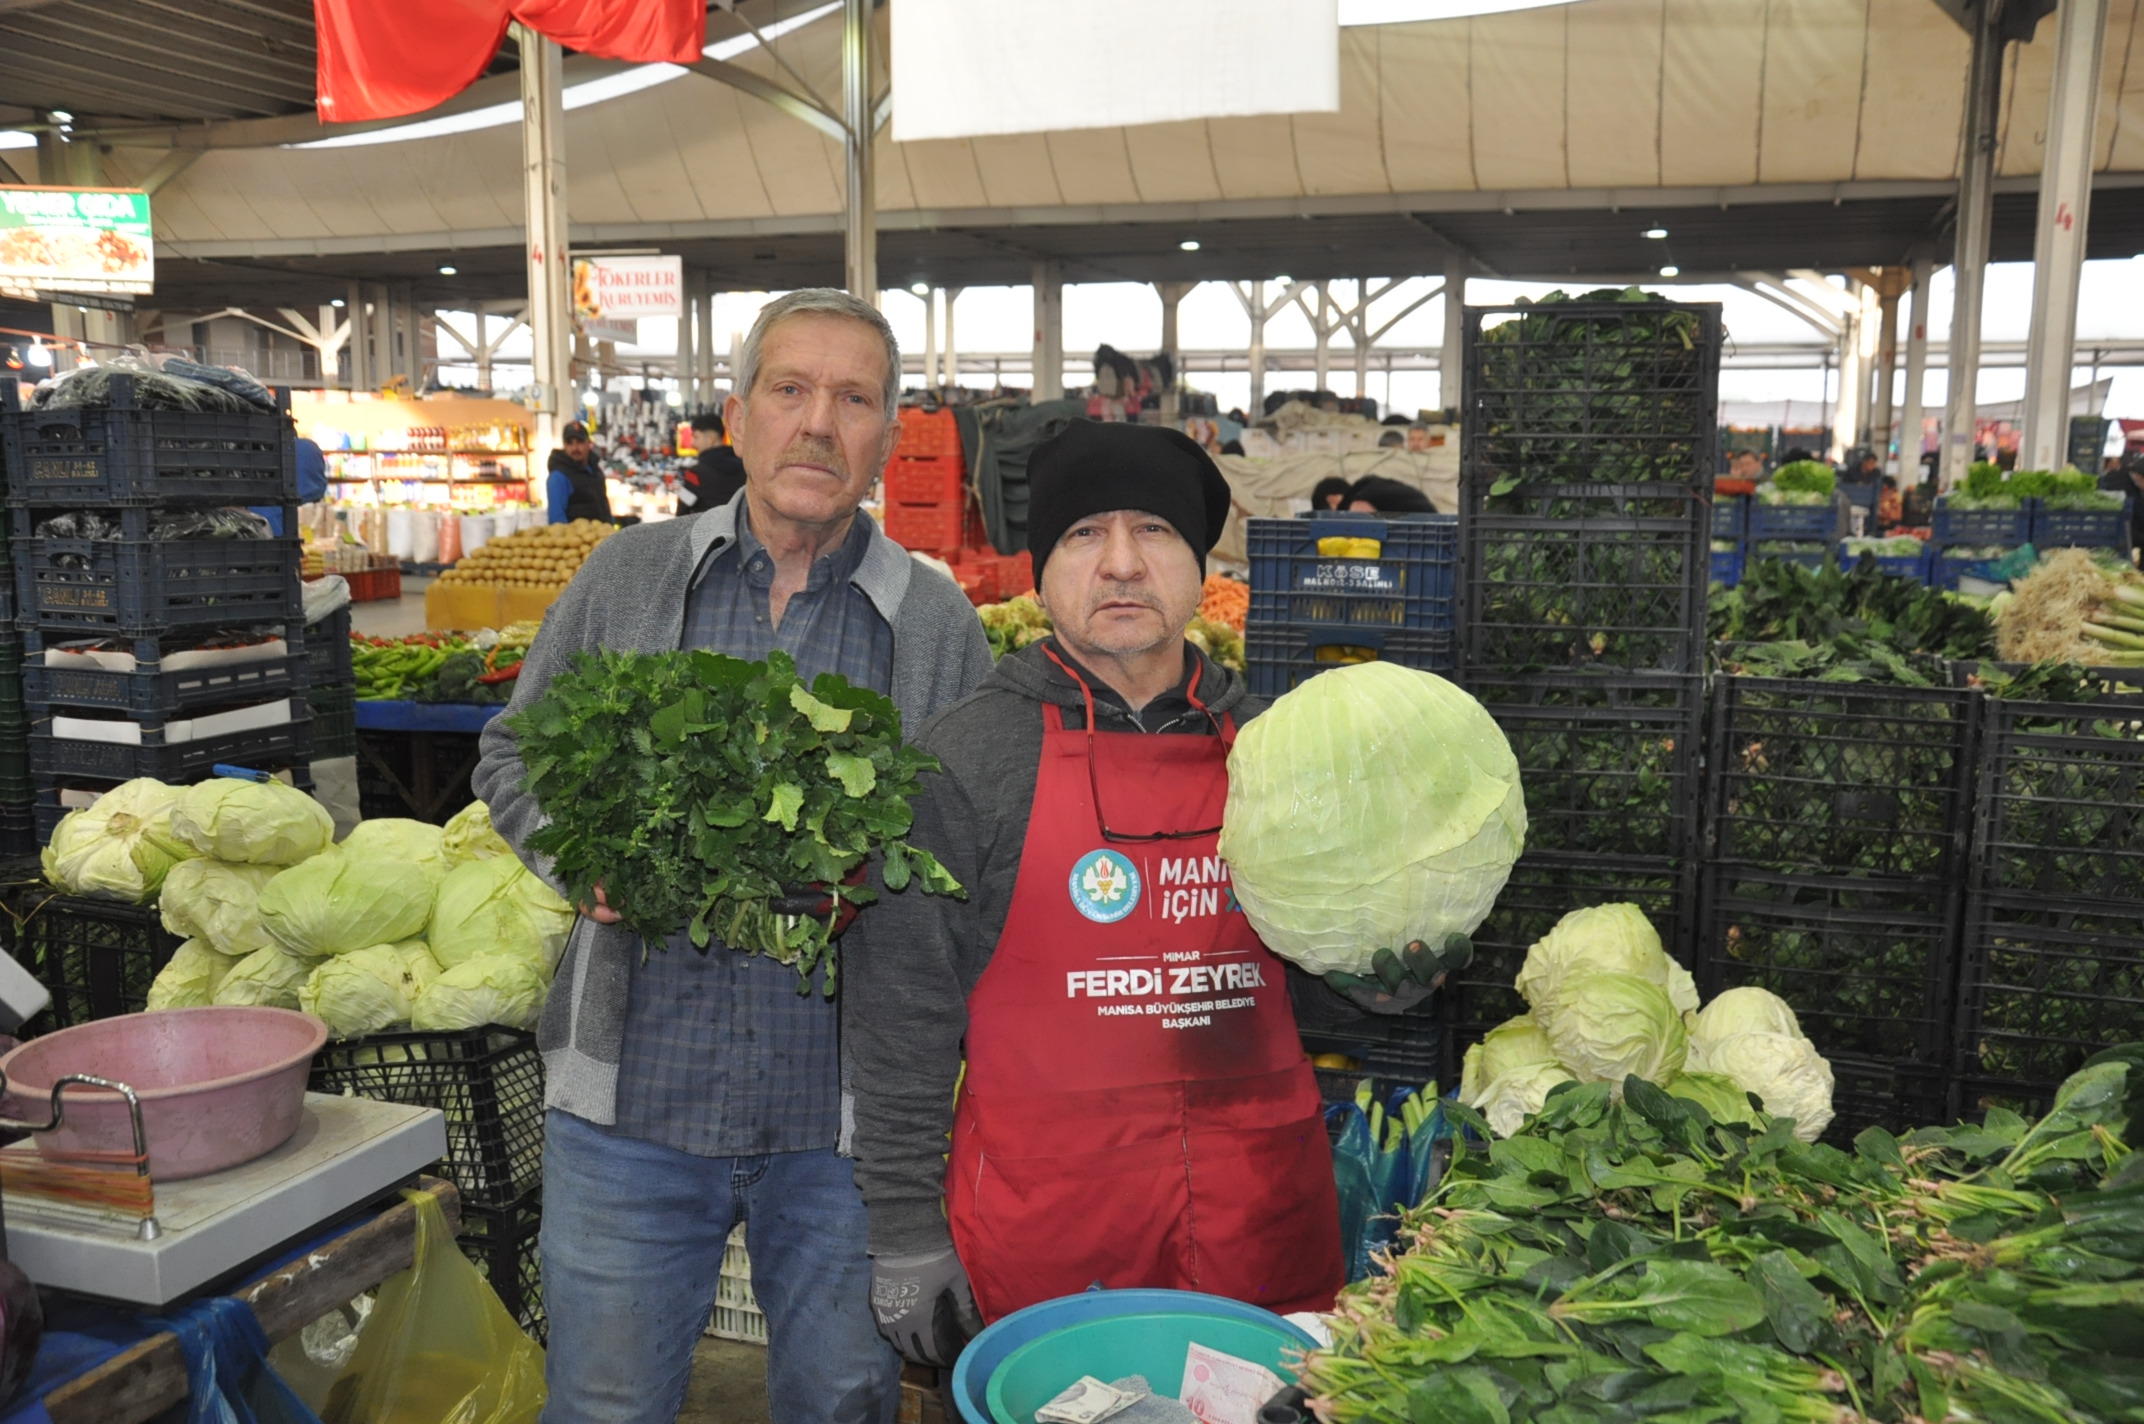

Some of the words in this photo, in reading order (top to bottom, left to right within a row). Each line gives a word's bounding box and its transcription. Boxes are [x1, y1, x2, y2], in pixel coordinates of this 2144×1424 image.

[1163, 951, 1200, 963] MİMAR
[1067, 968, 1163, 998] FERDİ
[1168, 962, 1266, 995] ZEYREK
[1097, 1004, 1144, 1016] MANİSA
[1145, 1000, 1215, 1015] BÜYÜKŞEHİR
[1215, 997, 1255, 1010] BELEDİYE
[1162, 1016, 1211, 1030] BAŞKANI
